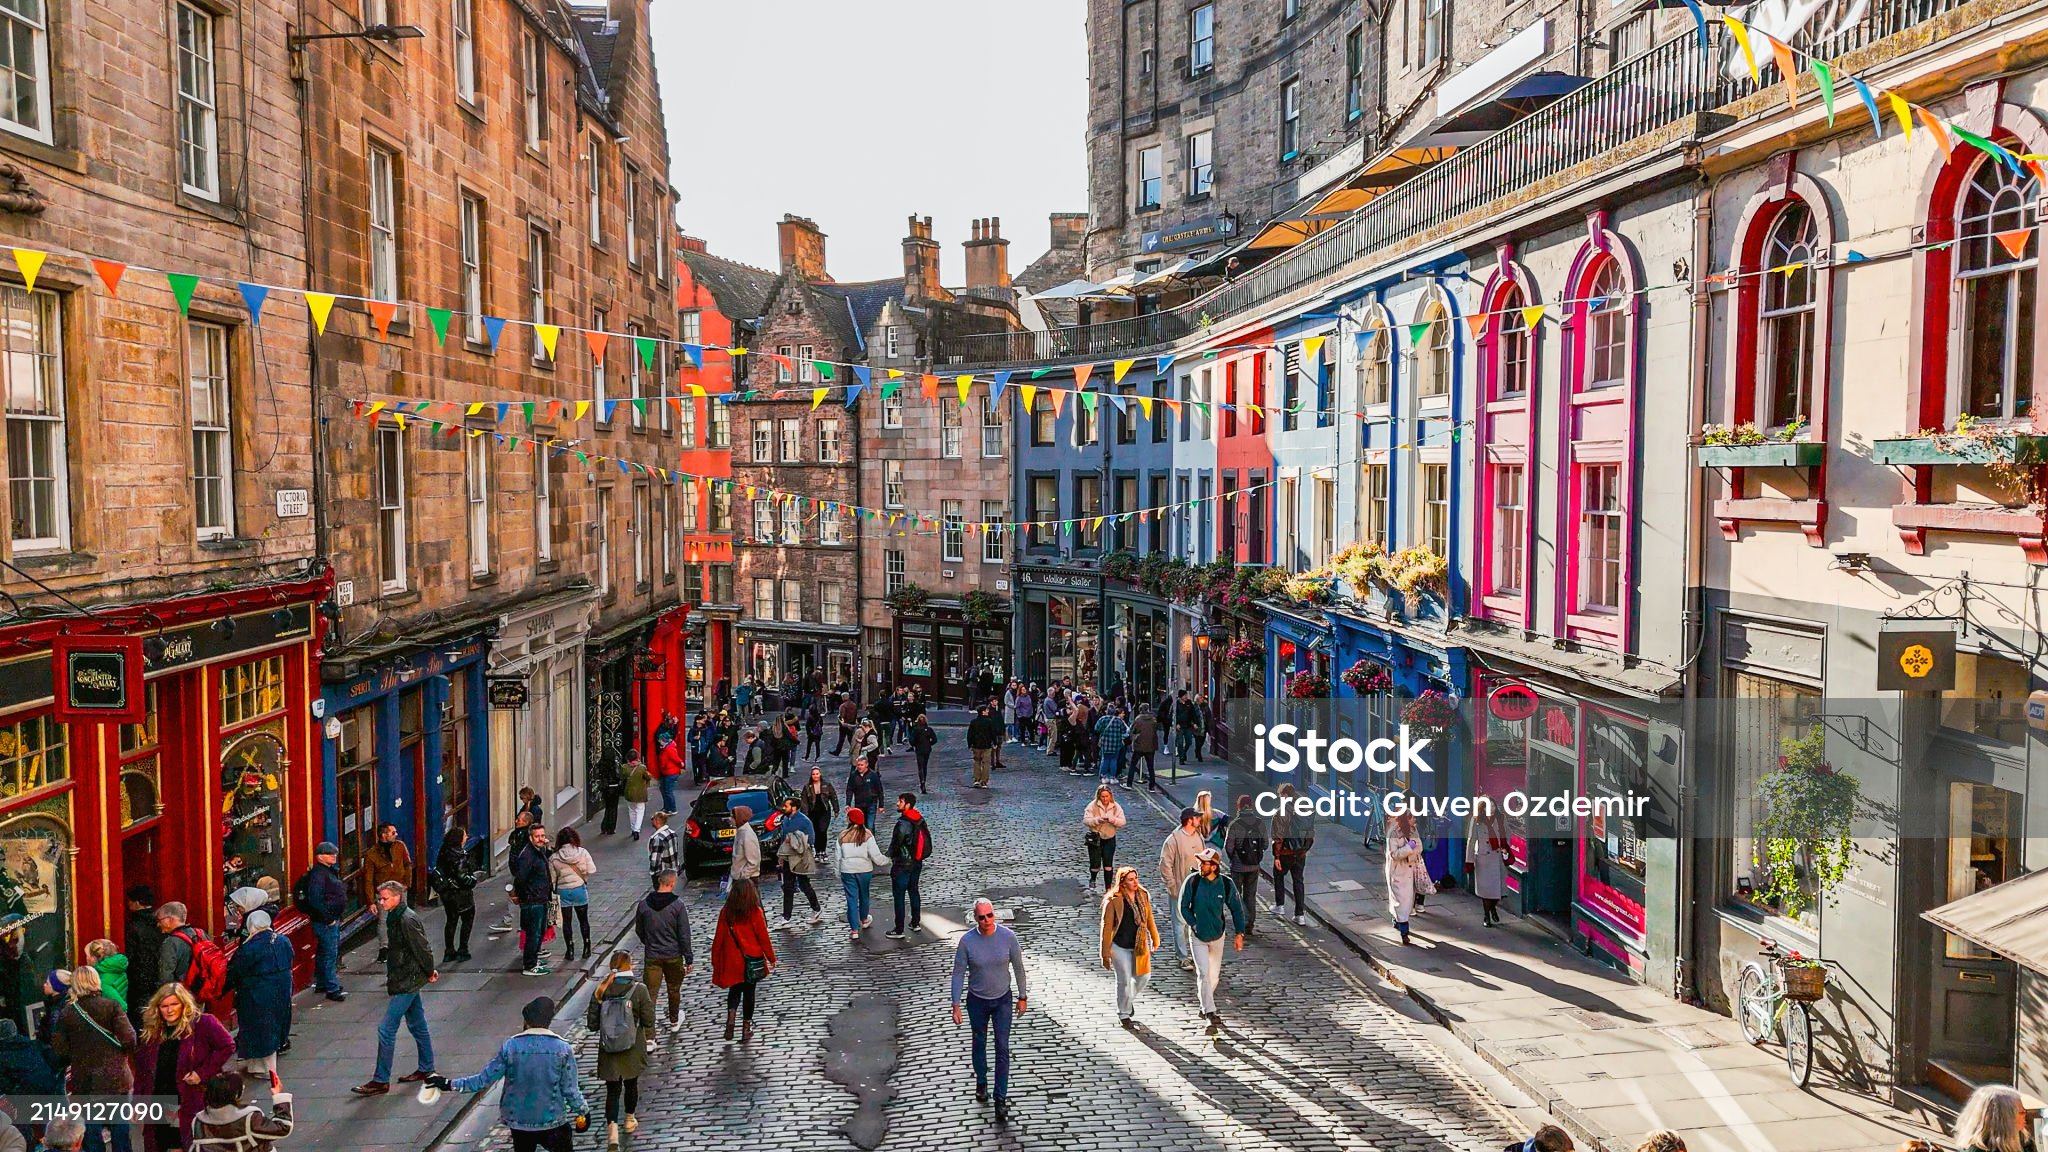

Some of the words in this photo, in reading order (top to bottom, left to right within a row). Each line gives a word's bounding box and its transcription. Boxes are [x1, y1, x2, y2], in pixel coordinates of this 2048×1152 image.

[278, 491, 306, 503] VICTORIA
[283, 503, 303, 514] STREET
[1043, 574, 1067, 585] Walker
[1070, 575, 1092, 587] Slater
[339, 582, 352, 593] WEST
[339, 593, 351, 605] BOW
[526, 613, 555, 637] SAHARA
[349, 680, 371, 698] SPIRIT
